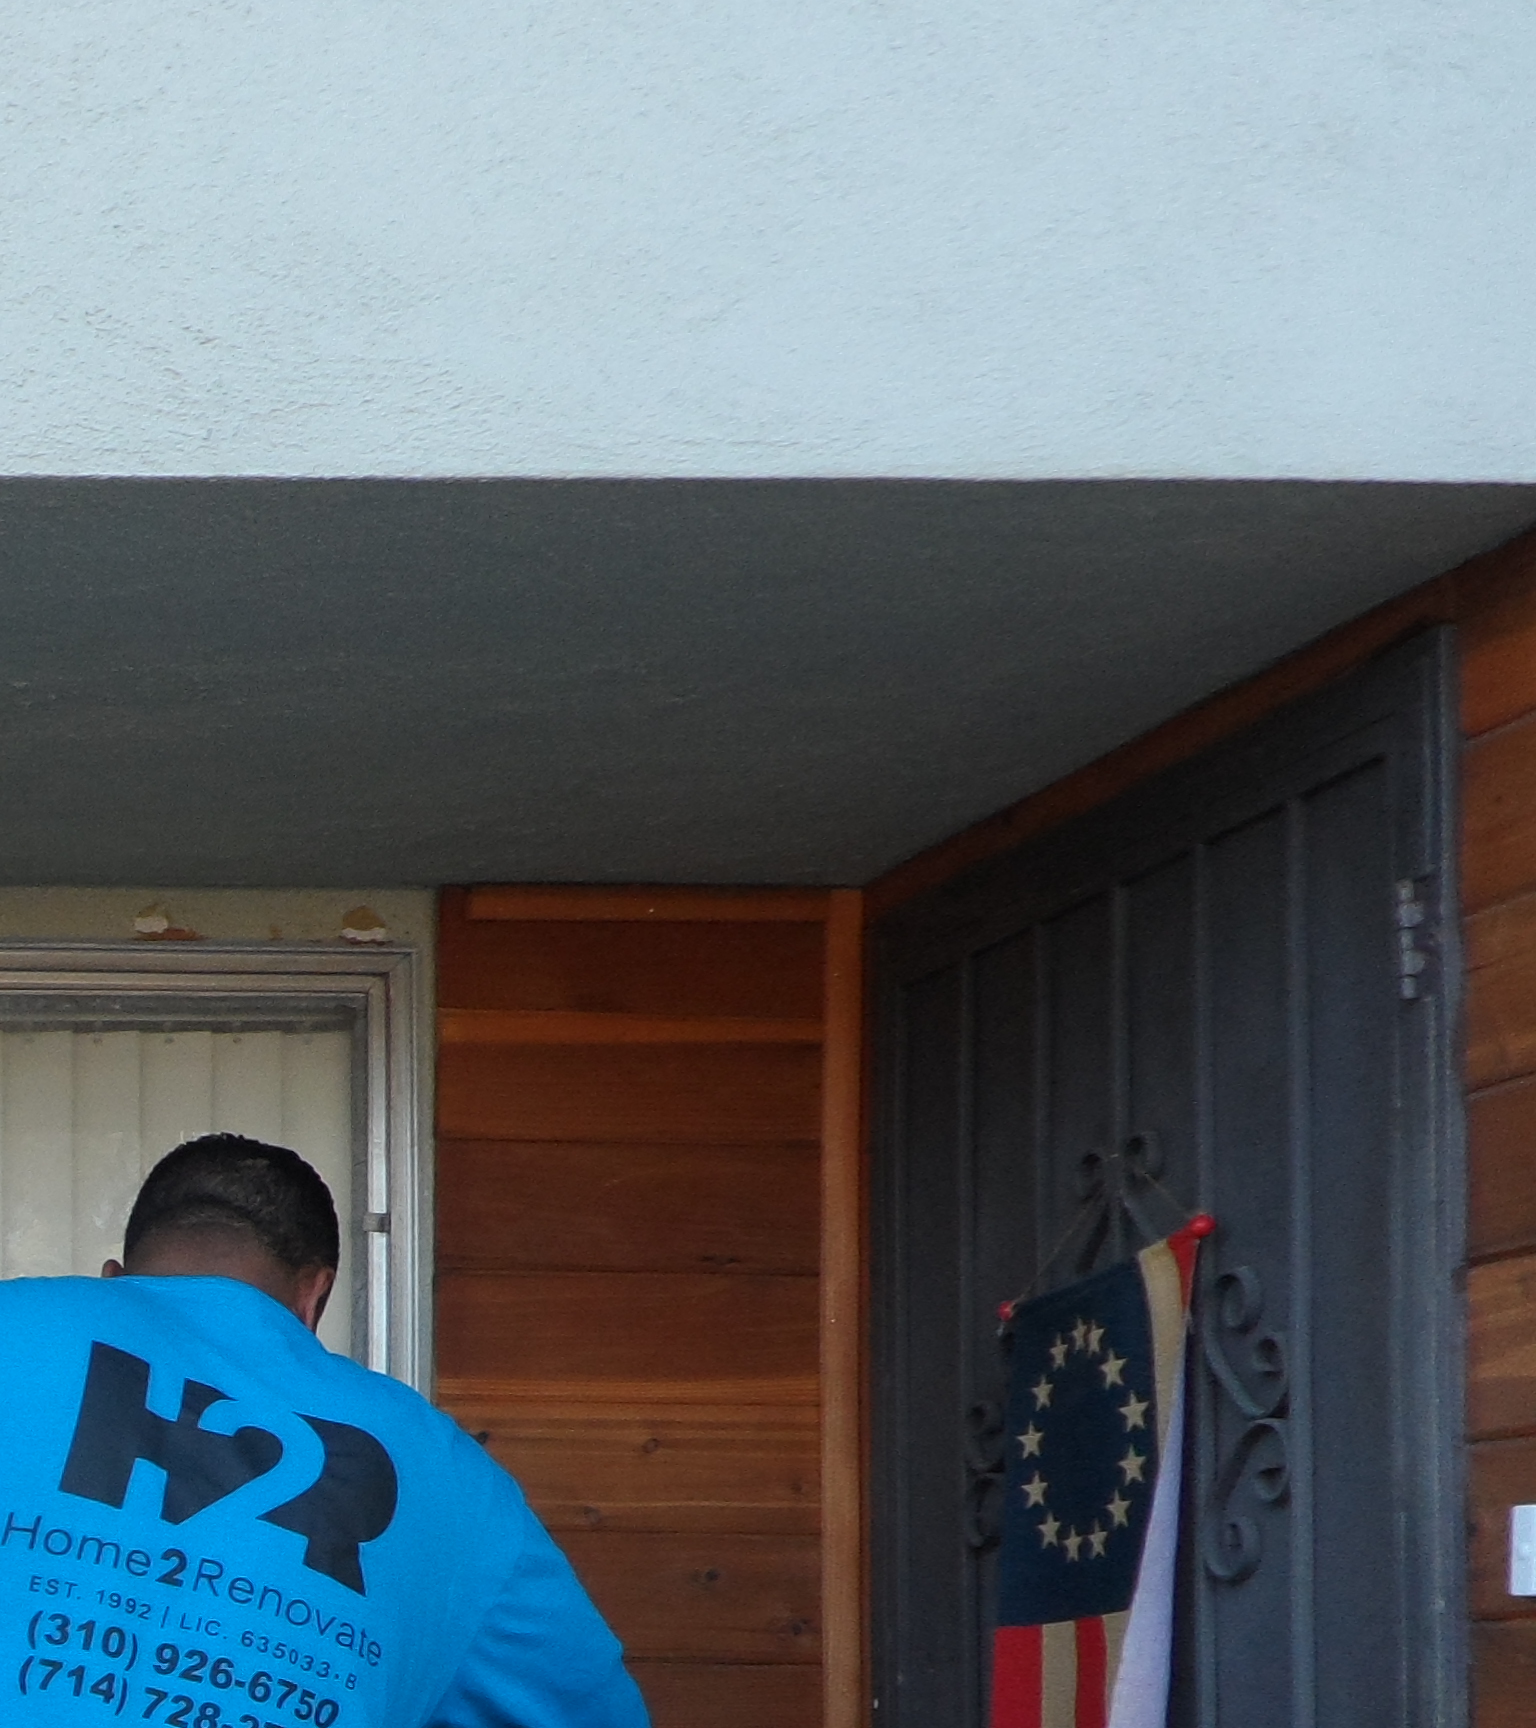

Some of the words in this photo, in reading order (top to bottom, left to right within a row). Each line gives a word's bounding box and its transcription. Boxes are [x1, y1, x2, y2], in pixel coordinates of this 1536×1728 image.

[58, 1339, 399, 1598] H2R
[1, 1511, 383, 1667] Home2Renovate
[29, 1575, 81, 1600] EST.
[96, 1589, 152, 1620] 1992
[179, 1612, 228, 1640] LIC.
[28, 1610, 138, 1672] (310)
[18, 1655, 128, 1716] (714)
